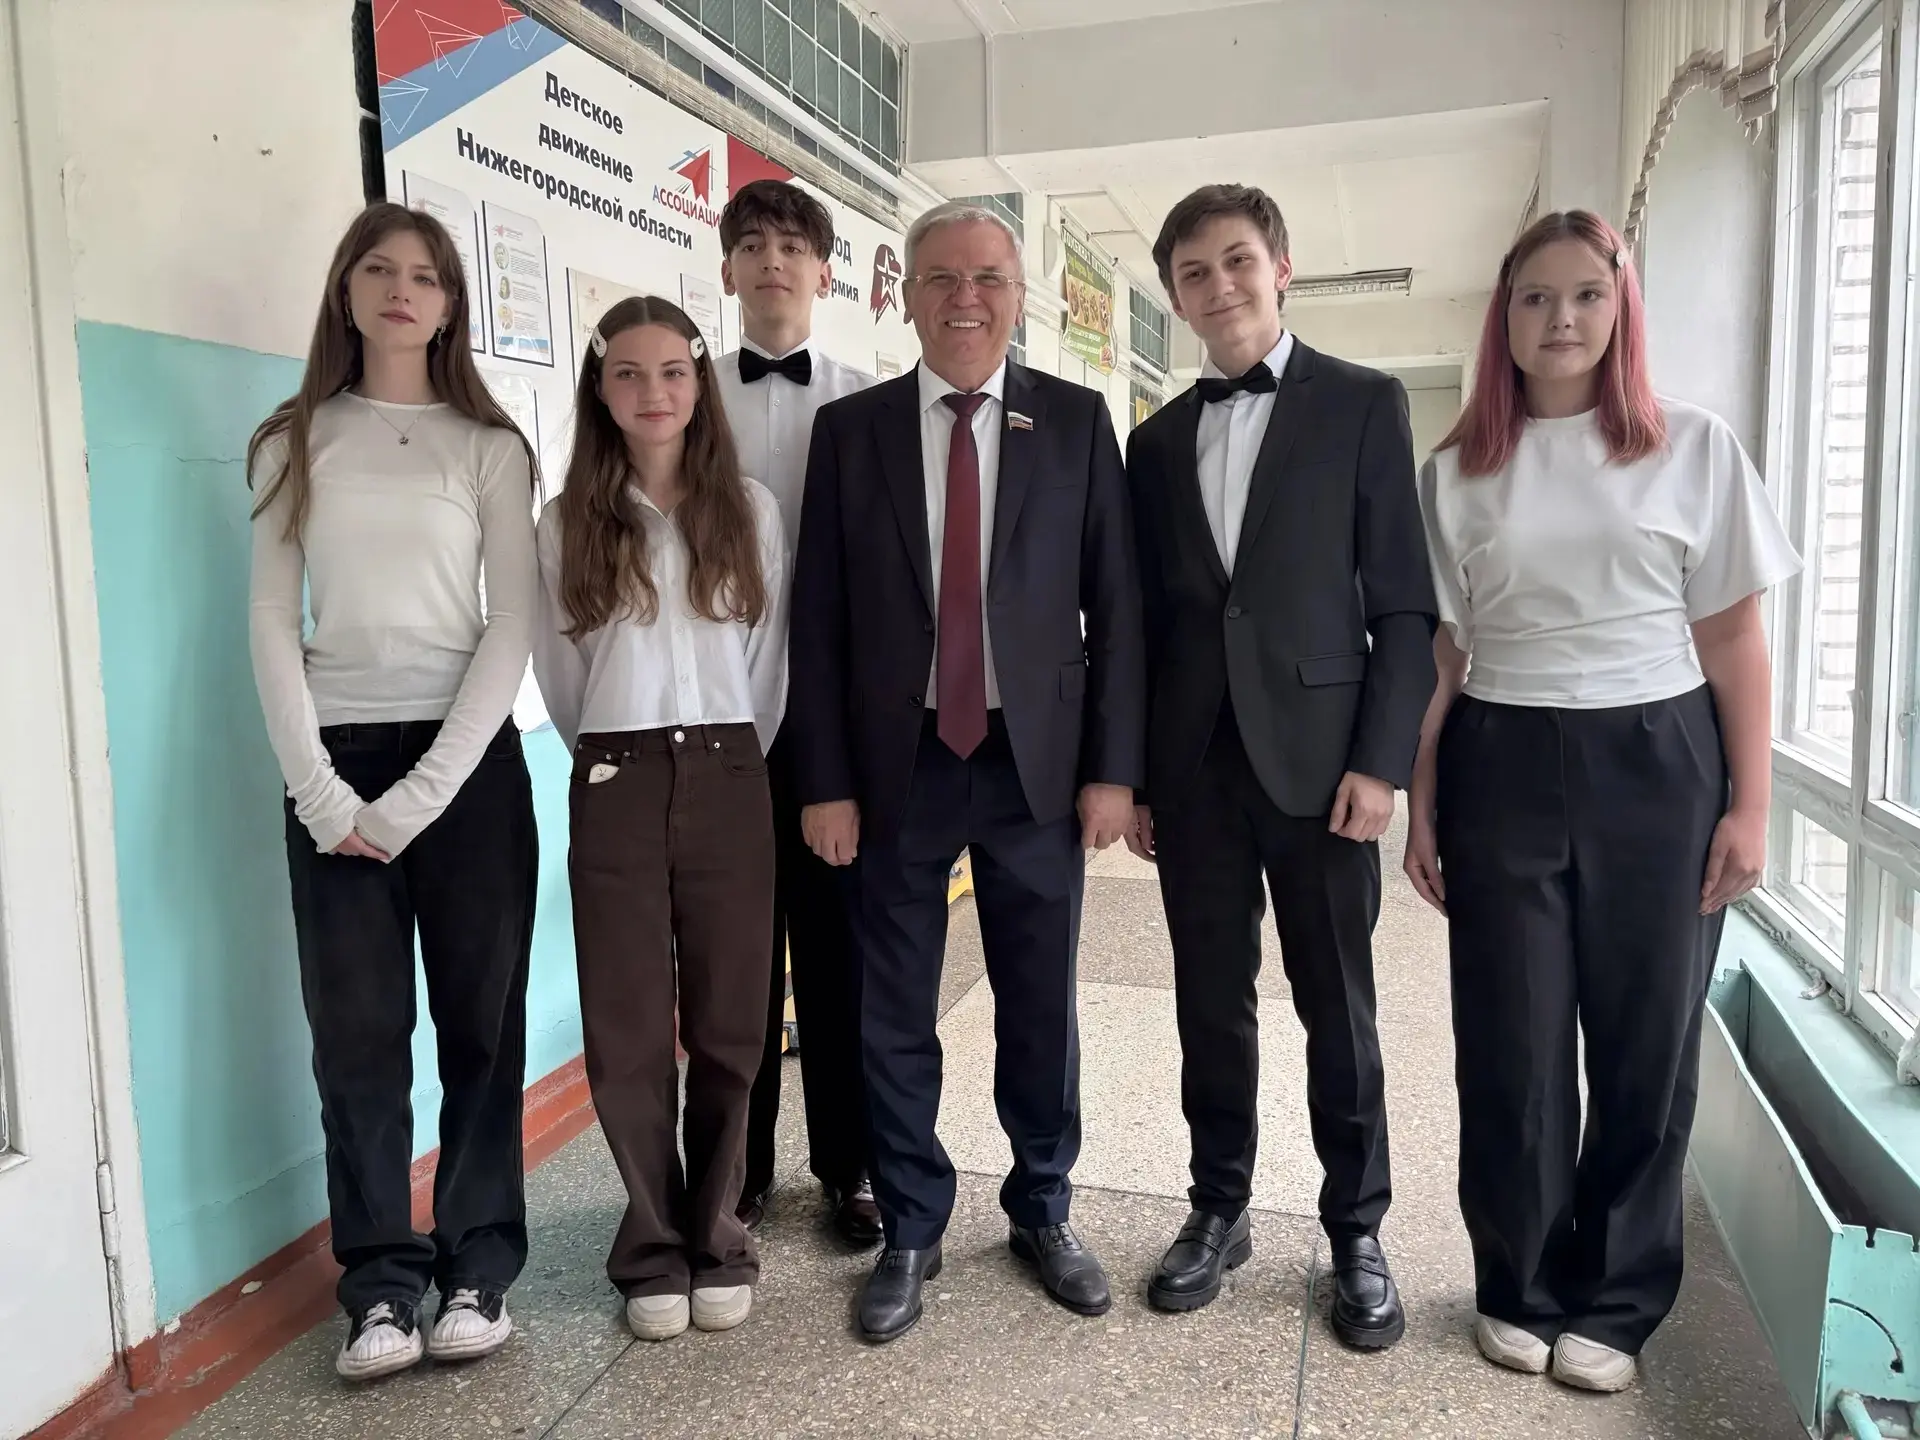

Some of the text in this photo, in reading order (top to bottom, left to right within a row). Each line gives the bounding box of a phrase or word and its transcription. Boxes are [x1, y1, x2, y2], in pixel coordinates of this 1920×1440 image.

[545, 71, 623, 134] Детское
[539, 123, 633, 183] движение
[457, 127, 692, 250] Нижегородской области
[652, 184, 720, 232] АССОЦИАЦИ
[831, 278, 859, 302] рмия
